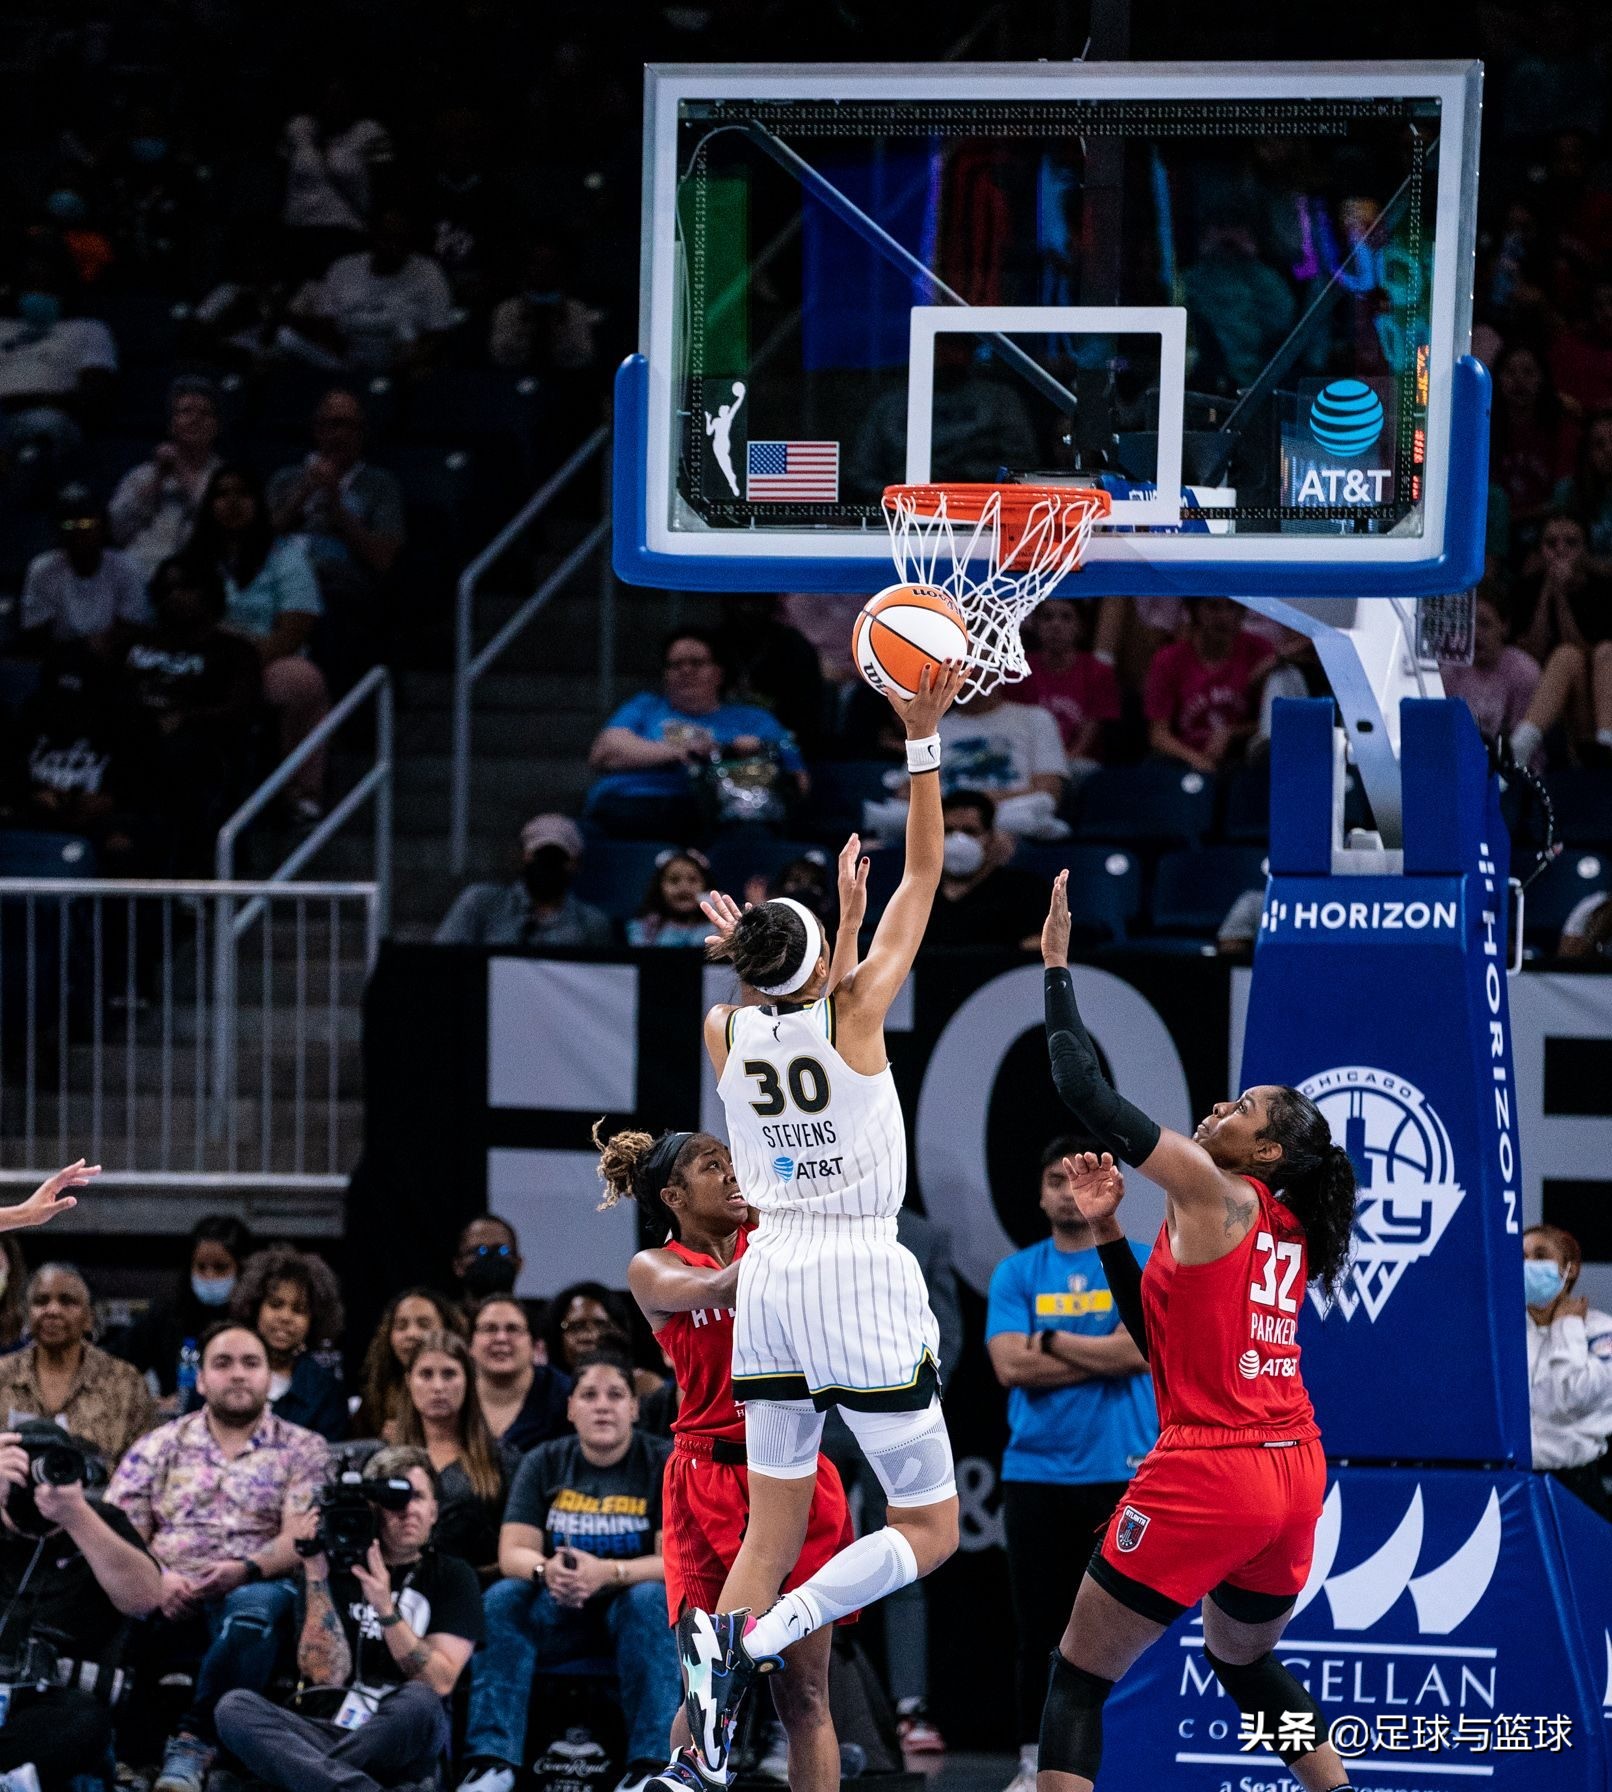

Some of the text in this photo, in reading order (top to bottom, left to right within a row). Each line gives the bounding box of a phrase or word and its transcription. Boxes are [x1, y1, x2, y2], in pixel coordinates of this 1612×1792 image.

[1298, 469, 1391, 502] AT&T
[1294, 902, 1456, 929] HORIZON
[743, 1055, 831, 1118] 30
[1303, 1070, 1412, 1098] CHICAGO
[1482, 910, 1518, 1234] HORIZON
[762, 1120, 836, 1148] STEVENS
[797, 1157, 843, 1180] AT&T
[1250, 1231, 1302, 1313] 32
[1250, 1312, 1297, 1346] PARKER
[1260, 1358, 1298, 1377] AT&T
[1179, 1653, 1496, 1709] MELLAN
